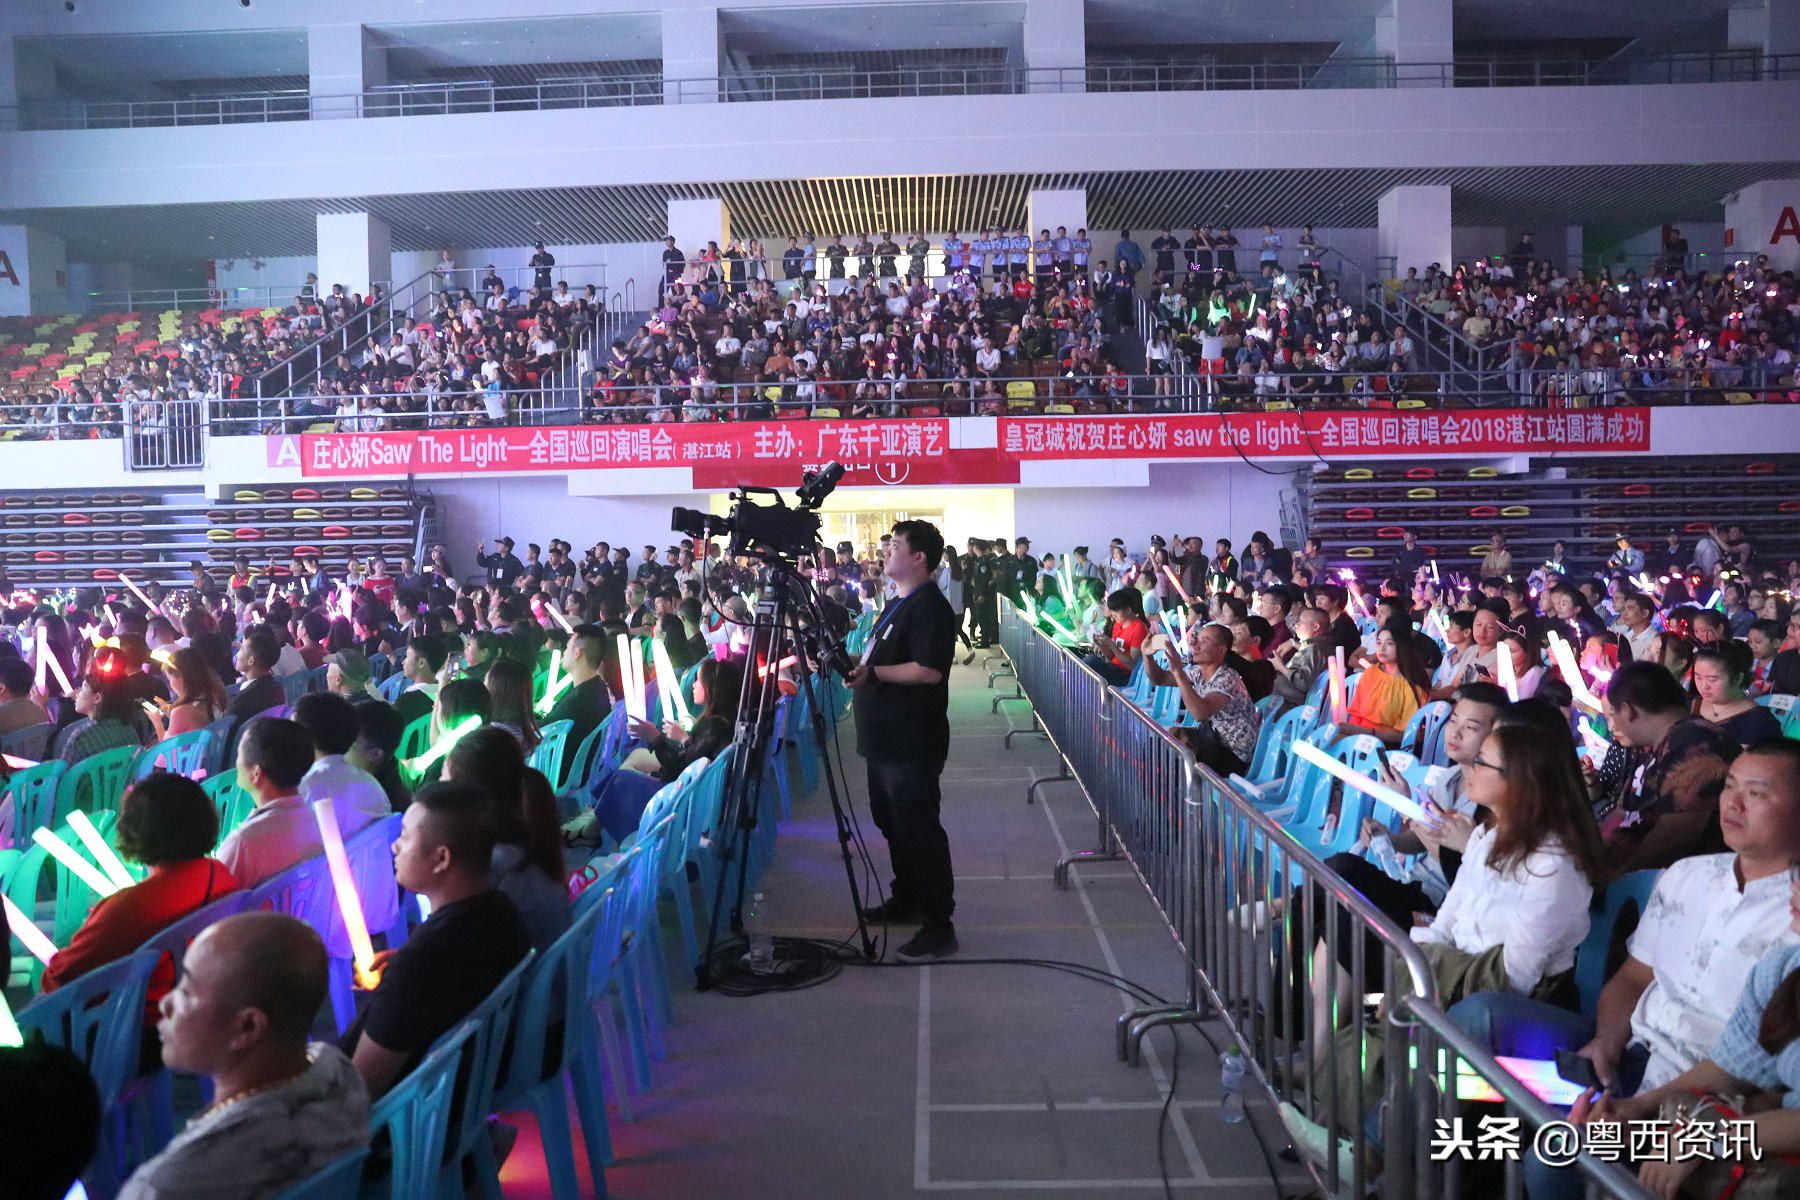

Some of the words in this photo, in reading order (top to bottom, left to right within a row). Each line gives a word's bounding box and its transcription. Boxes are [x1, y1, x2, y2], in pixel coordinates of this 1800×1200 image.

[276, 437, 300, 465] A
[418, 435, 454, 464] The
[1005, 421, 1168, 452] 皇冠城祝贺庄心妍
[1174, 428, 1213, 447] saw
[1218, 421, 1250, 447] the
